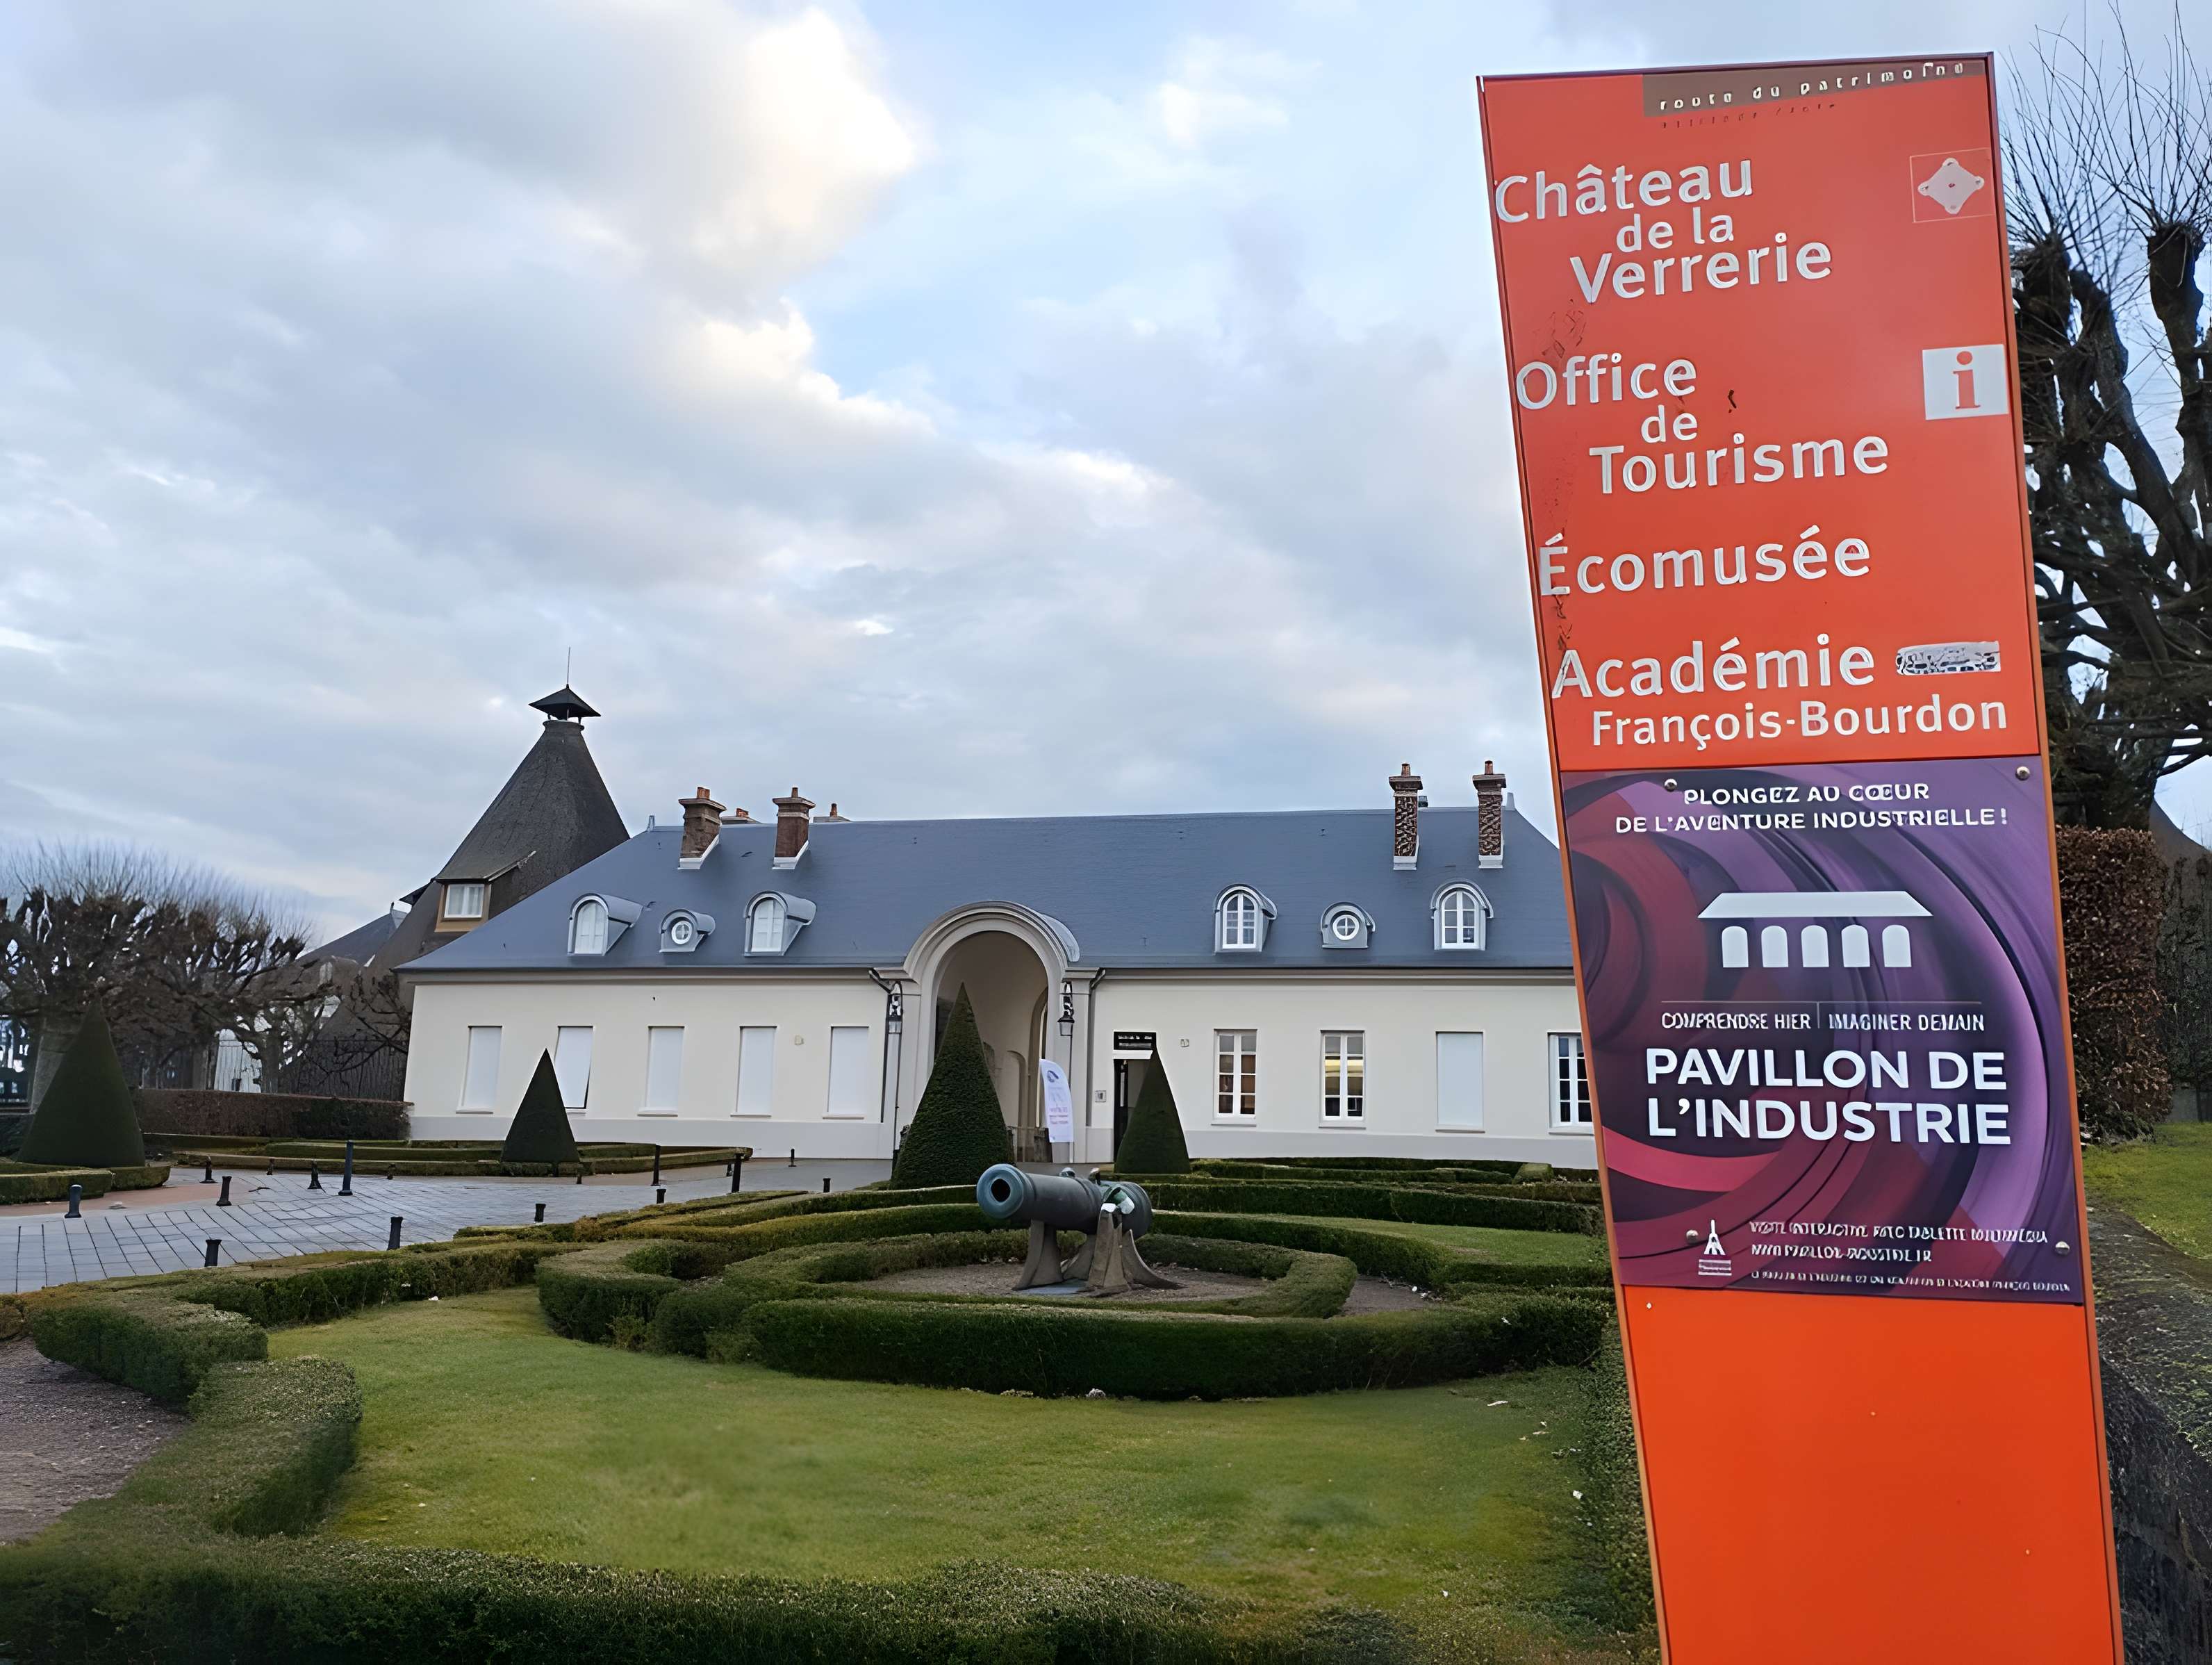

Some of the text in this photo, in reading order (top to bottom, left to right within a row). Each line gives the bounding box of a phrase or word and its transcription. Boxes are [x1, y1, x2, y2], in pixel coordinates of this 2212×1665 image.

[1494, 160, 1752, 223] Château
[1616, 206, 1734, 253] de la
[1569, 232, 1831, 303] Verrerie
[1516, 352, 1697, 410] Office
[1641, 404, 1698, 443] de
[1589, 432, 1888, 494] Tourisme
[1540, 525, 1870, 596] Écomusée
[1551, 633, 1874, 699] Académie
[1592, 694, 2006, 751] François-Bourdon
[1616, 817, 1647, 833] DE
[1655, 813, 1806, 832] L'AVENTURE
[1684, 787, 1800, 805] PLONGEZ
[1807, 786, 1840, 802] AU
[1774, 1013, 1811, 1030] HIER
[1646, 1048, 2007, 1090] PAVILLON DE
